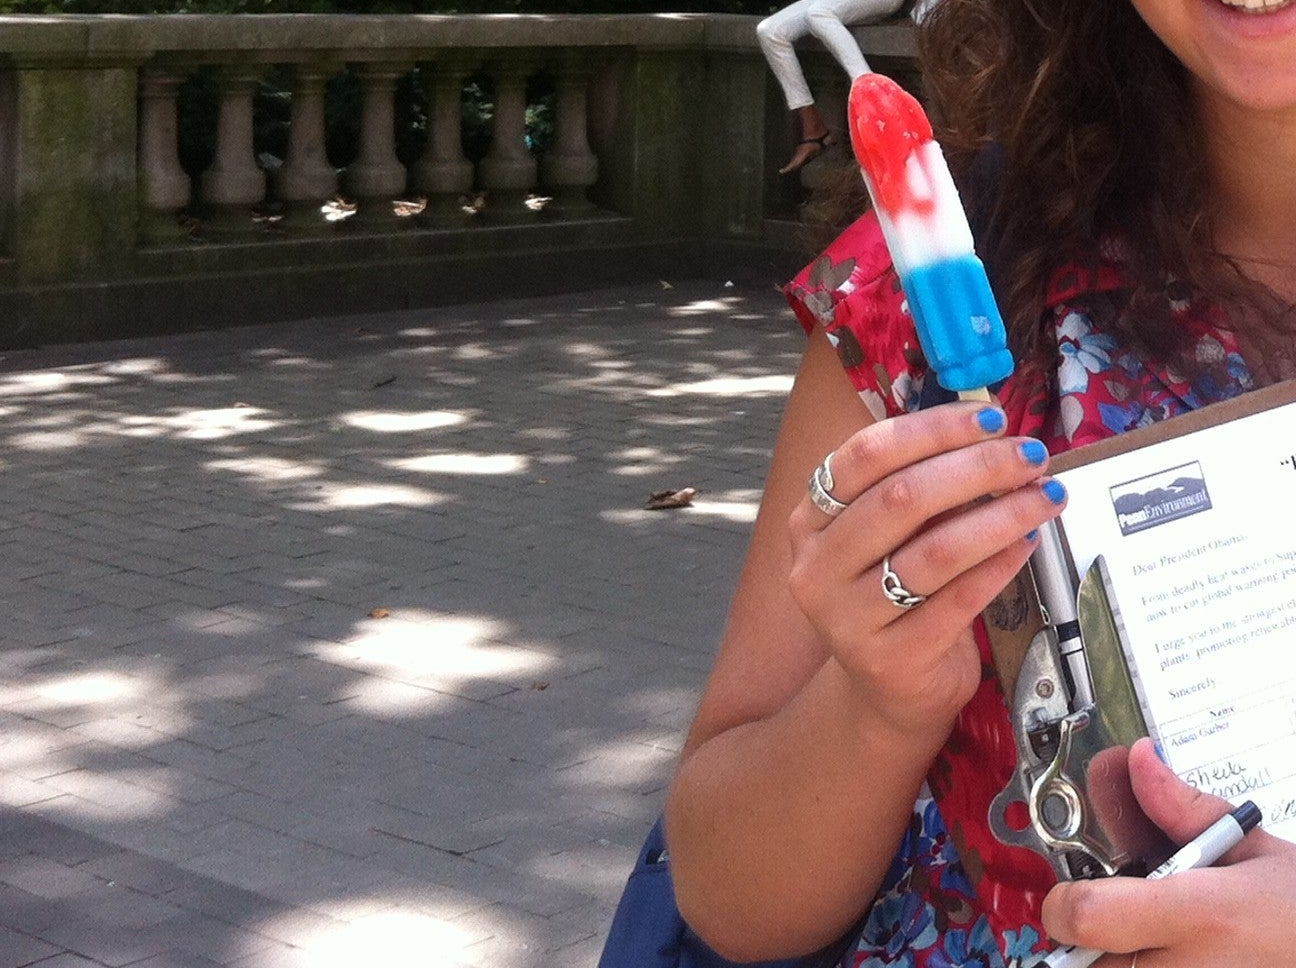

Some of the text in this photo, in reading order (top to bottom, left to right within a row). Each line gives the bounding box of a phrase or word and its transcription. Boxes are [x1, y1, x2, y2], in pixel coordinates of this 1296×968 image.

[1118, 489, 1208, 528] PennEnvironment
[1132, 561, 1157, 577] Dear
[1159, 545, 1207, 568] President
[1140, 592, 1170, 607] From
[1171, 579, 1205, 598] deadly
[1206, 571, 1229, 585] heat
[1230, 562, 1262, 576] waves
[1146, 608, 1168, 623] now
[1169, 605, 1182, 615] to
[1182, 597, 1200, 611] cut
[1201, 584, 1233, 606] global
[1234, 572, 1279, 592] warming
[1153, 642, 1161, 655] I
[1162, 637, 1186, 652] urge
[1187, 629, 1208, 644] you
[1208, 626, 1221, 636] to
[1240, 603, 1285, 625] strongest
[1195, 633, 1249, 660] promoting
[1170, 721, 1230, 748] Adam Garber
[1216, 767, 1274, 800] andall
